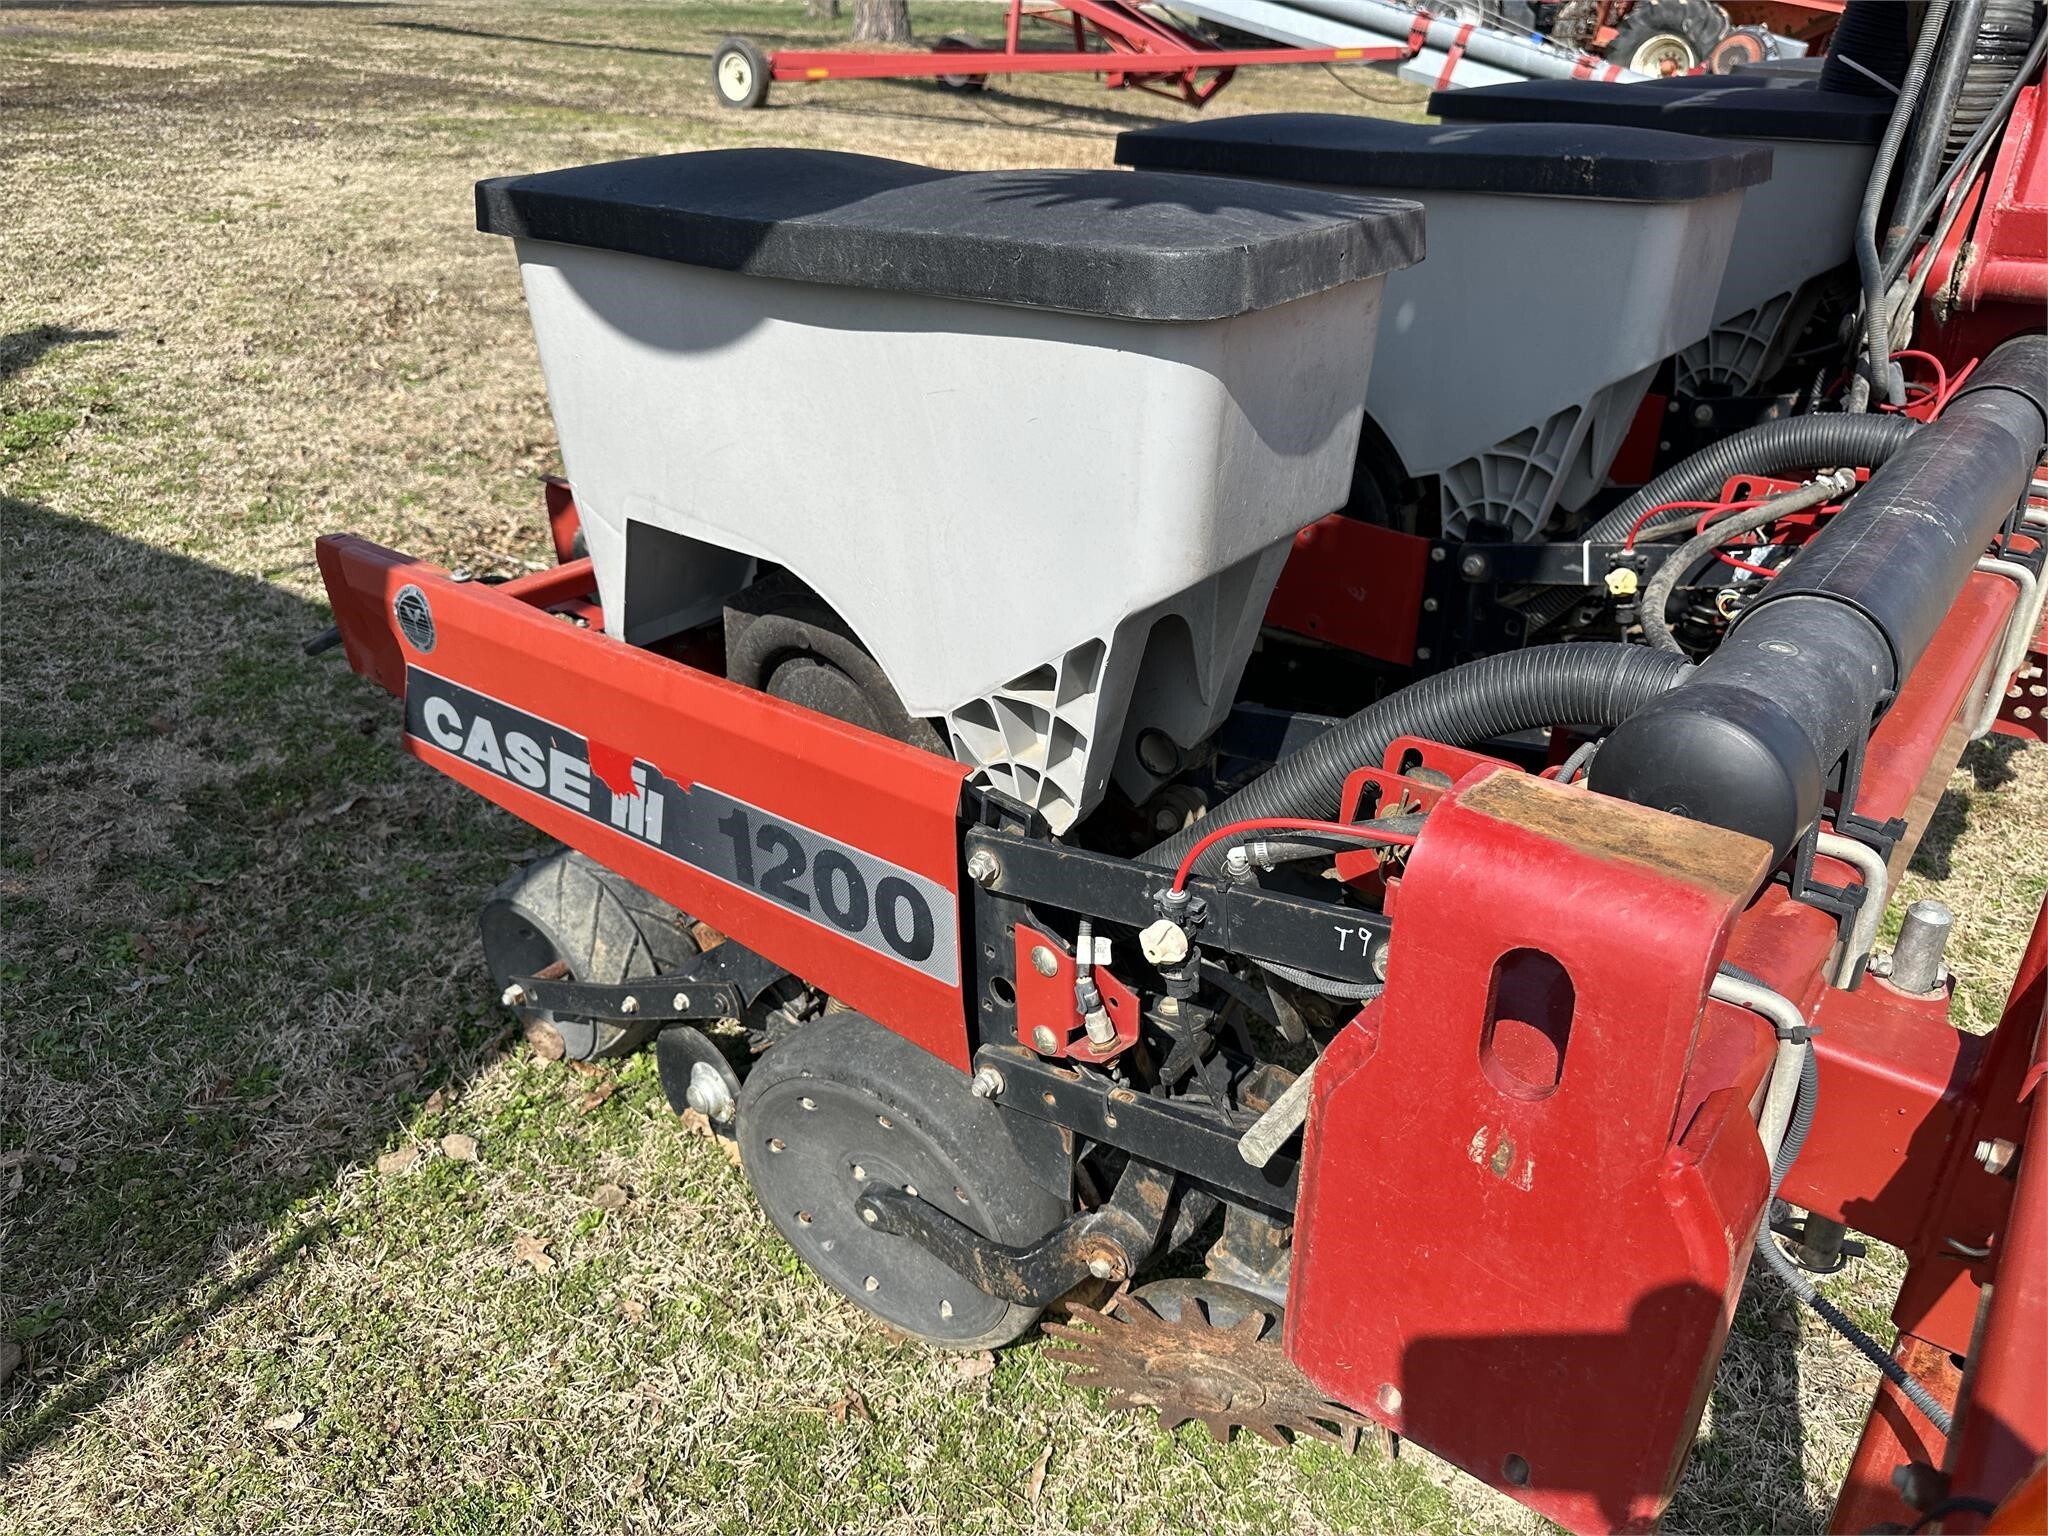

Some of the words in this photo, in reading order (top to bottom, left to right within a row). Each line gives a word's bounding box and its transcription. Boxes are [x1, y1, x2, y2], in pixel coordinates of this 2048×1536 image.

[424, 696, 590, 812] CASE
[718, 808, 935, 962] 1200
[1334, 926, 1372, 957] T9
